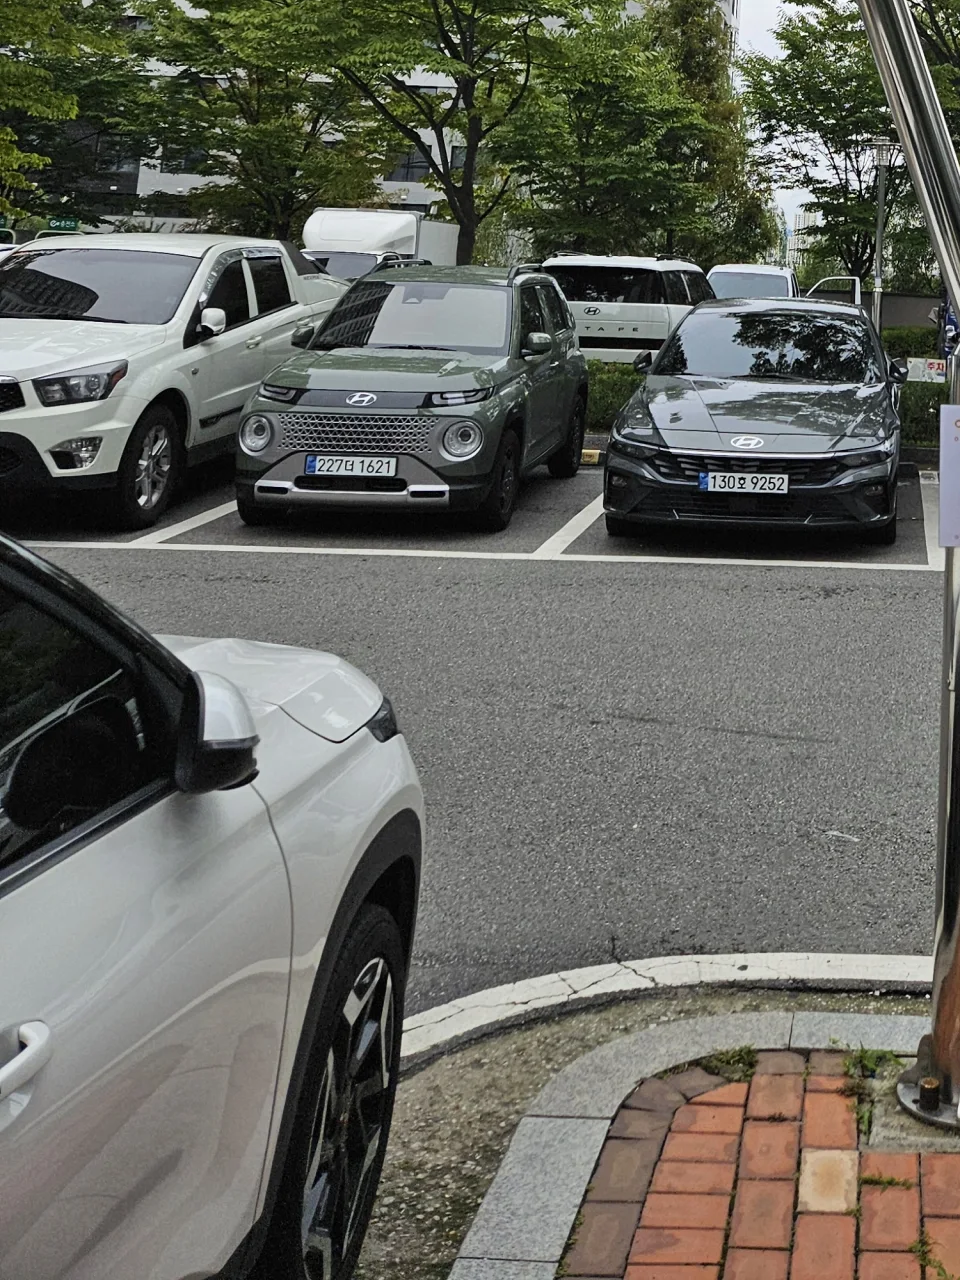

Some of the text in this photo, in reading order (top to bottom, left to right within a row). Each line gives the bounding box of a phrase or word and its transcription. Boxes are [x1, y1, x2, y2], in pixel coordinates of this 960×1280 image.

[927, 362, 945, 371] 주차
[317, 458, 391, 474] 227더 1621
[710, 474, 785, 491] 130호 9252
